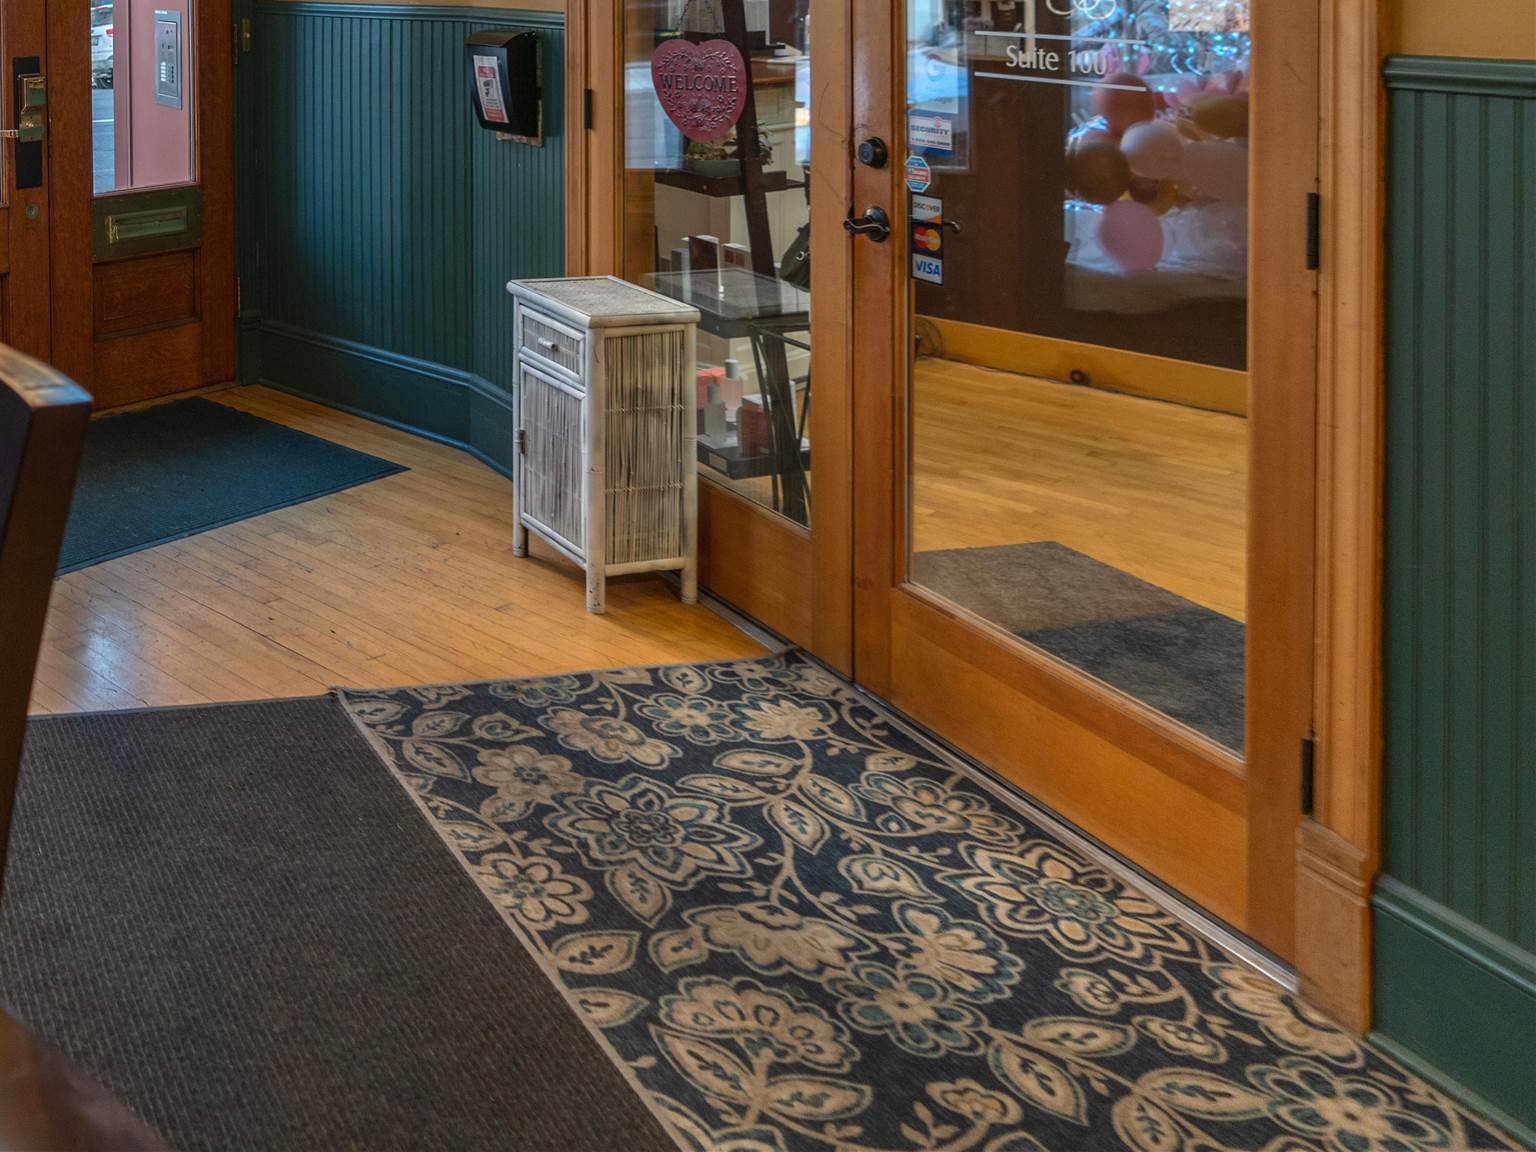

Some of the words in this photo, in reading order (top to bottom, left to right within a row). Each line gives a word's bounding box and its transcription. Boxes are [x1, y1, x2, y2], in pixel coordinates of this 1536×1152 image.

[1006, 45, 1059, 71] Suite
[1068, 50, 1107, 75] 100
[658, 72, 738, 94] WELCOME
[916, 259, 941, 277] VISA
